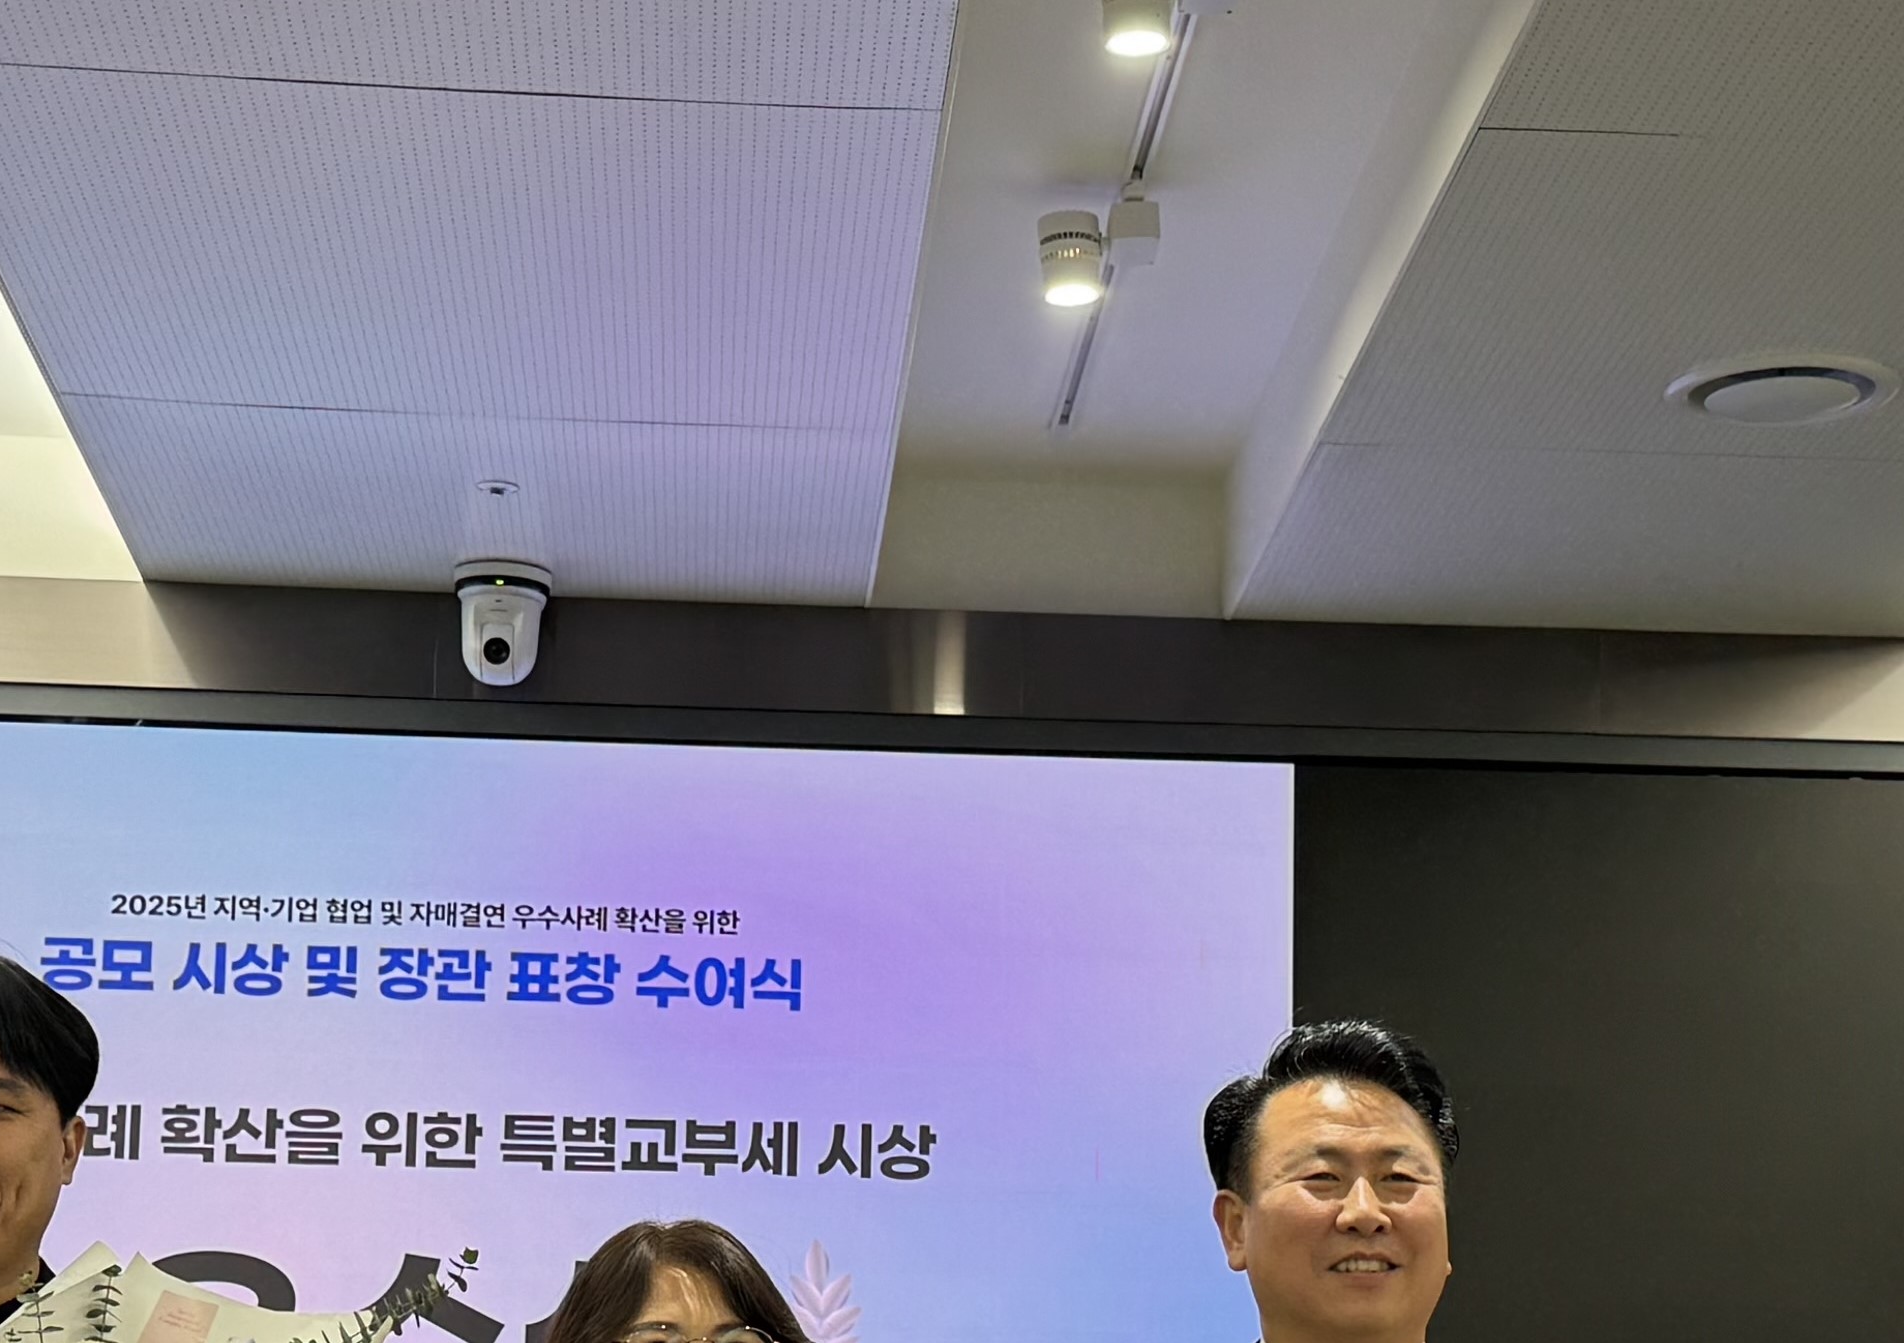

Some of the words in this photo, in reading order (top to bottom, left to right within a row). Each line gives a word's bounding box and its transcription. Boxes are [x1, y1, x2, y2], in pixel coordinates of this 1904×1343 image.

[111, 894, 206, 920] 2025년
[213, 895, 318, 923] 지역·기업
[326, 898, 373, 925] 협업
[381, 900, 403, 926] 및
[409, 902, 506, 928] 자매결연
[512, 904, 607, 932] 우수사례
[614, 907, 685, 934] 확산을
[692, 909, 740, 936] 위한
[39, 935, 155, 992] 공모
[172, 942, 290, 997] 시상
[306, 945, 358, 999] 및
[378, 947, 492, 1002] 장관
[506, 951, 621, 1005] 표창
[635, 954, 802, 1012] 수여식
[160, 1104, 343, 1165] 확산을
[361, 1110, 484, 1169] 위한
[499, 1114, 798, 1178] 특별교부세
[817, 1123, 937, 1181] 시상
